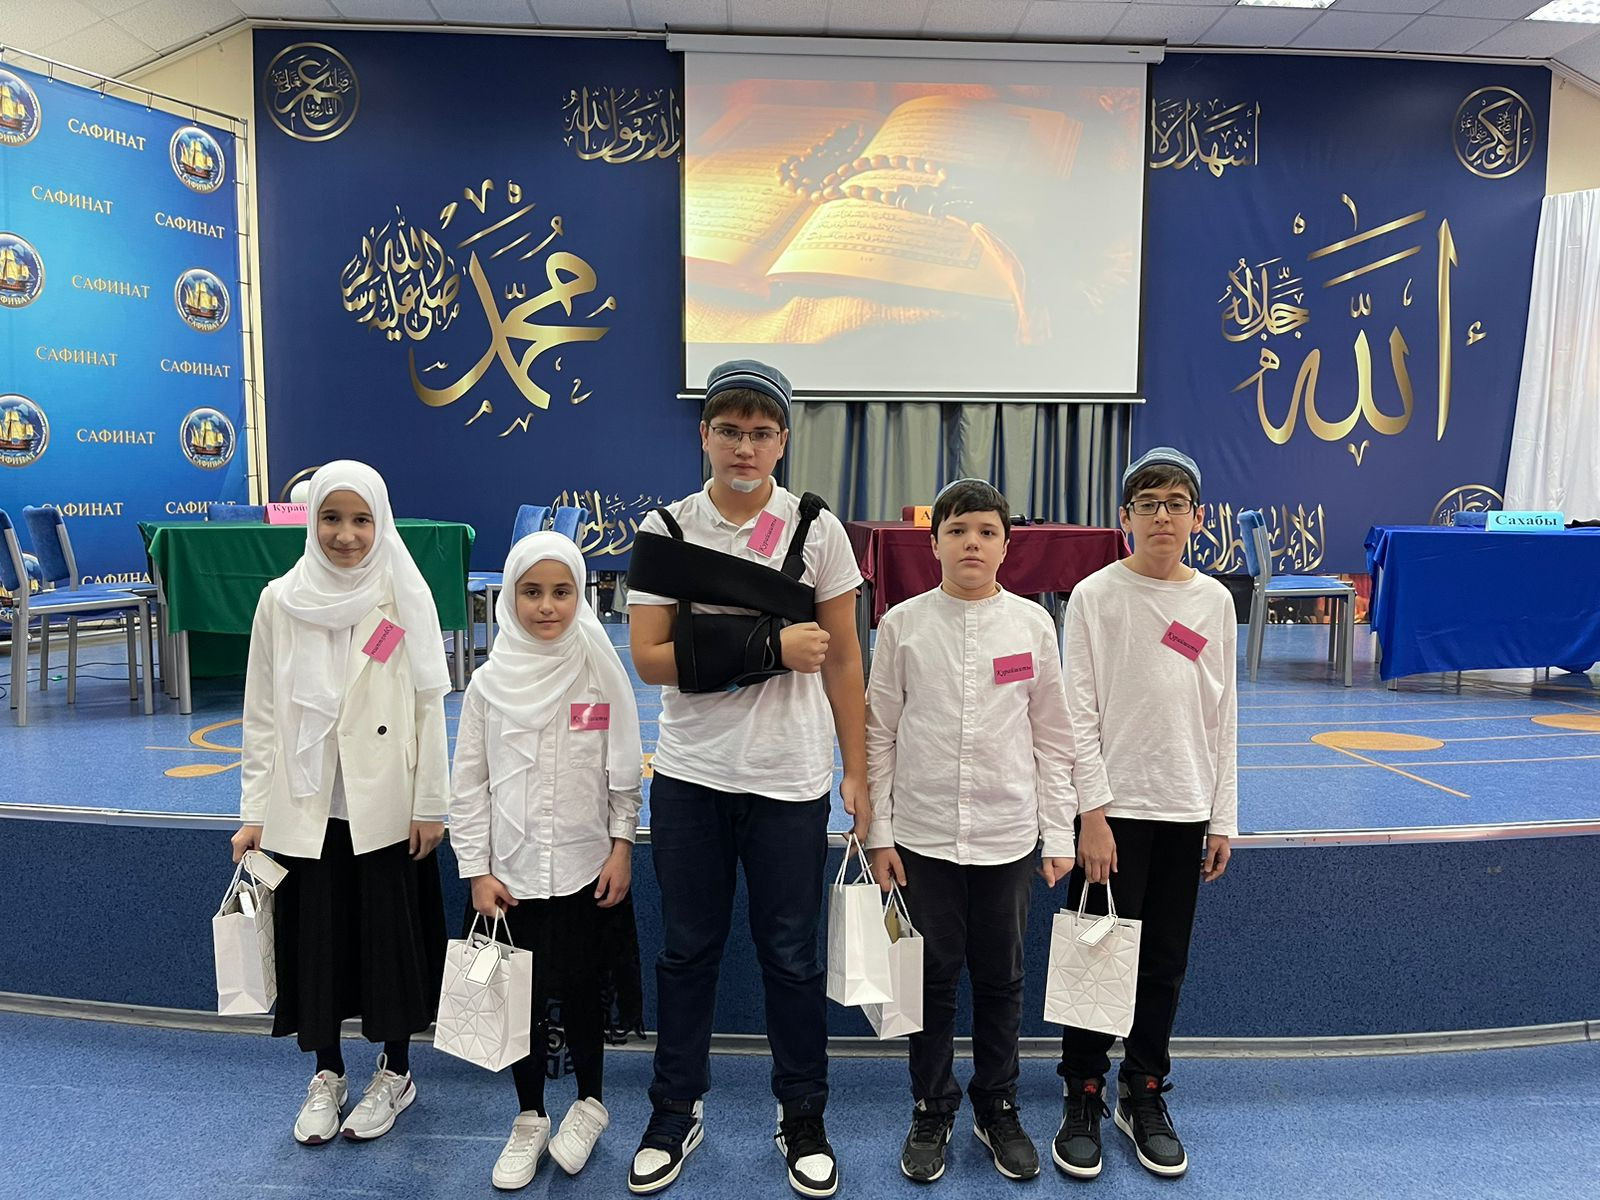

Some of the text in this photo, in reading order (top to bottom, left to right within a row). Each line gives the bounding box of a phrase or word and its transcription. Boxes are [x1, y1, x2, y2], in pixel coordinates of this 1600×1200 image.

[68, 118, 146, 151] САФИНАТ
[31, 185, 113, 215] САФИНАТ
[155, 212, 225, 239] САФИНАТ
[72, 275, 150, 299] САФИНАТ
[36, 346, 118, 367] САФИНАТ
[160, 358, 230, 378] САФИНАТ
[77, 429, 156, 445] САФИНАТ
[166, 501, 237, 514] САФИ
[273, 504, 308, 514] Курай
[920, 510, 931, 520] А
[1495, 514, 1557, 526] Сахабы
[82, 572, 152, 585] САФИНА
